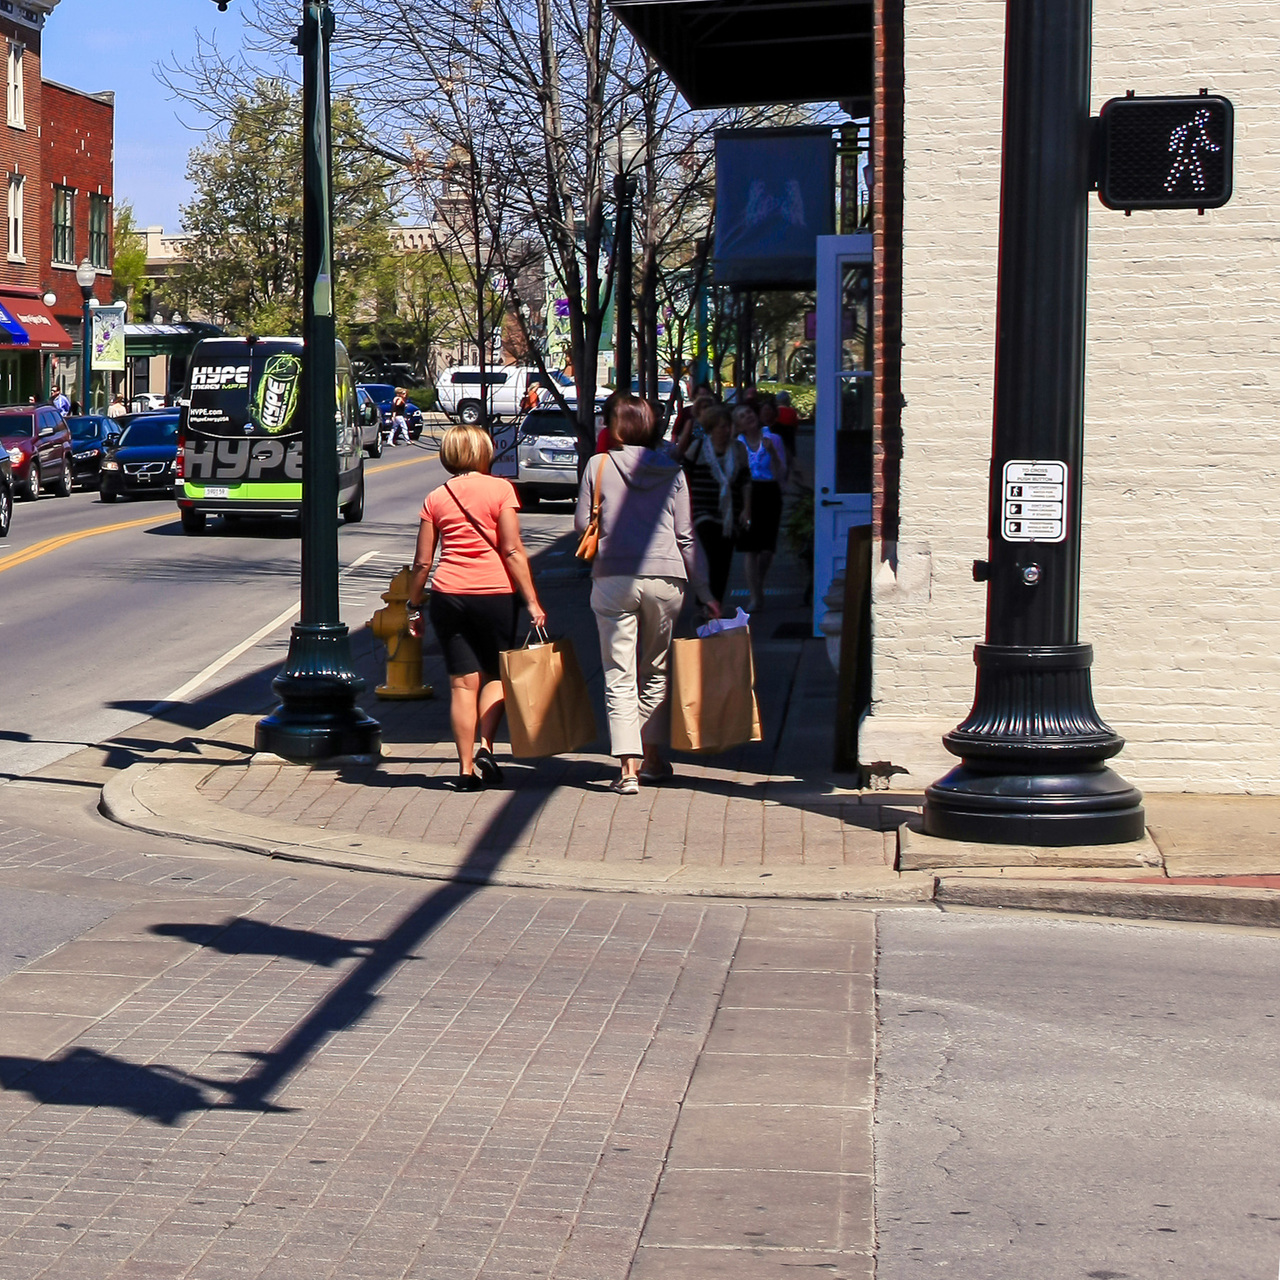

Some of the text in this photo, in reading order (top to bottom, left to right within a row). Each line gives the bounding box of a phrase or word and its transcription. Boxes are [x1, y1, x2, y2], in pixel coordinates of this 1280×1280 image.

[191, 366, 250, 384] HYPE
[262, 376, 287, 427] HYPE
[184, 440, 303, 479] HYPE
